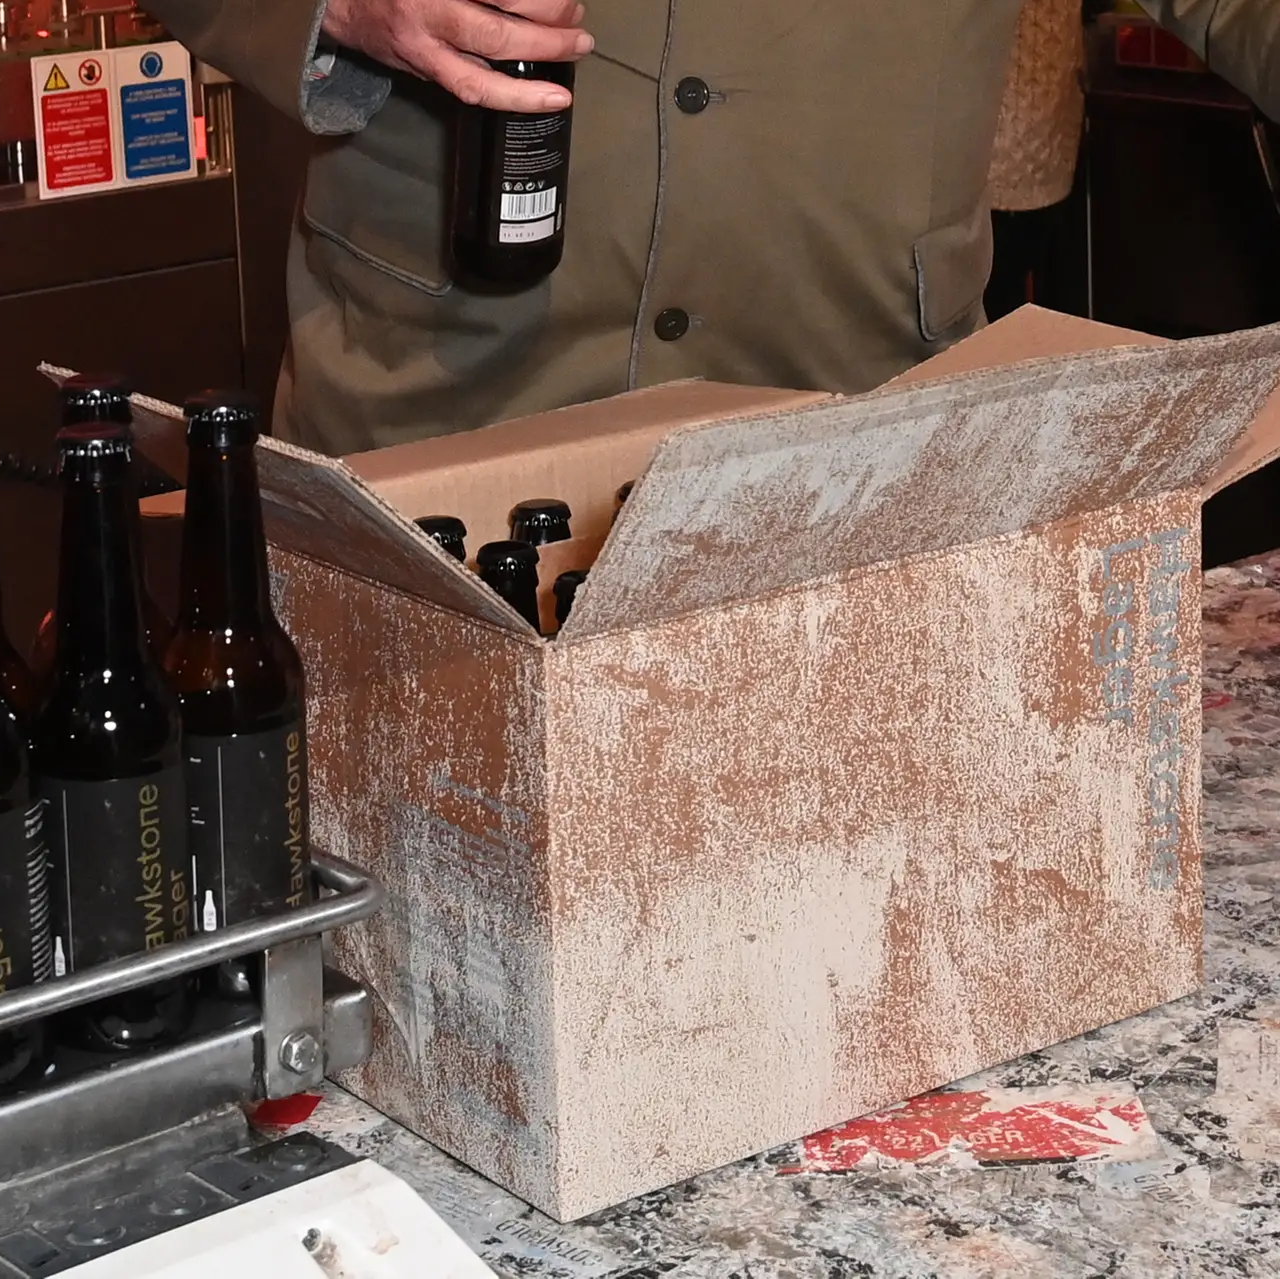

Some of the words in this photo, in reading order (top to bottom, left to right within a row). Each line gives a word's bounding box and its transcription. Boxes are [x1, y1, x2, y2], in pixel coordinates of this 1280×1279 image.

[1092, 536, 1146, 728] Lager
[1147, 526, 1192, 892] Hawkstone
[135, 782, 166, 951] awkstone
[169, 869, 192, 942] ager
